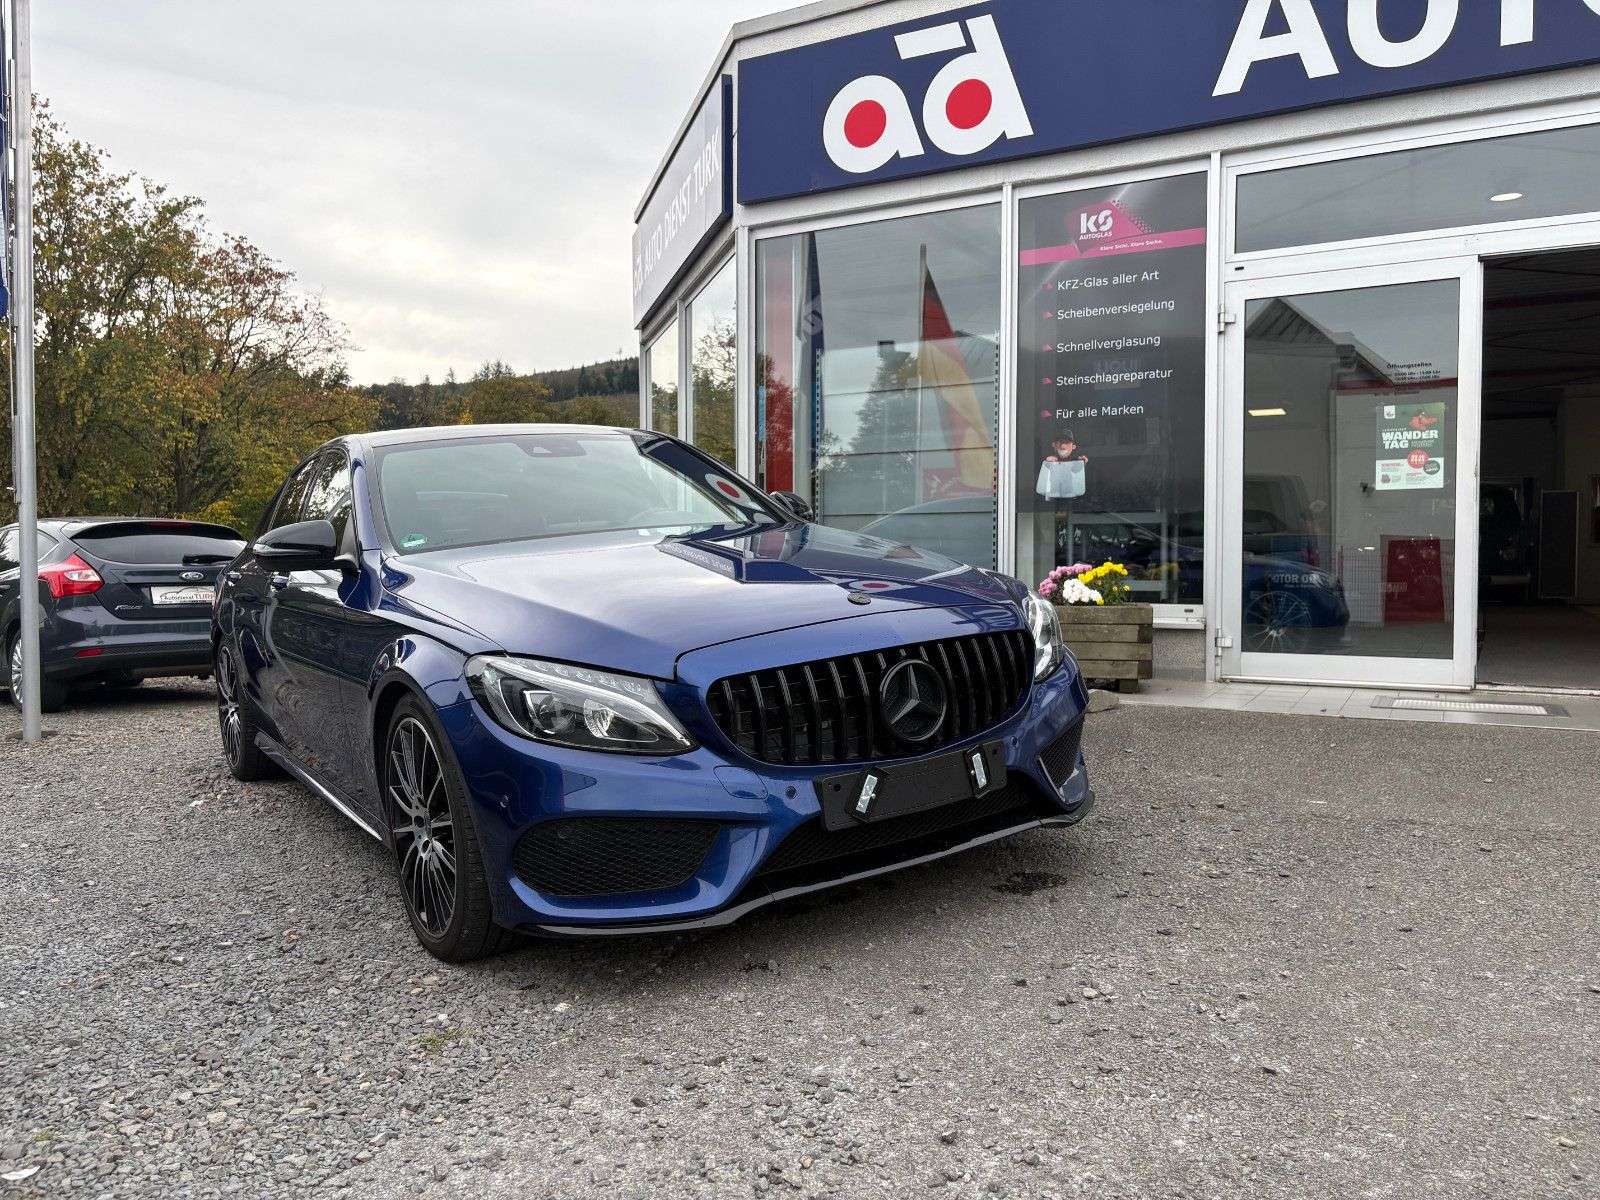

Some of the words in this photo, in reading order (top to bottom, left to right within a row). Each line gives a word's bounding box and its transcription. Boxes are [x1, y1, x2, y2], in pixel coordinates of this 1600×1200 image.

[644, 223, 663, 279] AUTO
[664, 174, 692, 249] DIENST
[1079, 231, 1113, 240] AUTOGLAS
[1057, 277, 1109, 291] KFZ-Glas
[1112, 273, 1136, 284] aller
[1141, 271, 1160, 281] Art
[1057, 299, 1175, 320] Scheibenversiegelung
[1056, 335, 1161, 353] Schnellverglasung
[1056, 368, 1174, 386] Steinschlagreparatur
[1056, 408, 1073, 419] Für
[1077, 407, 1097, 417] alle
[1101, 405, 1144, 416] Marken
[1381, 430, 1438, 441] WANDER
[1382, 440, 1409, 449] TAG
